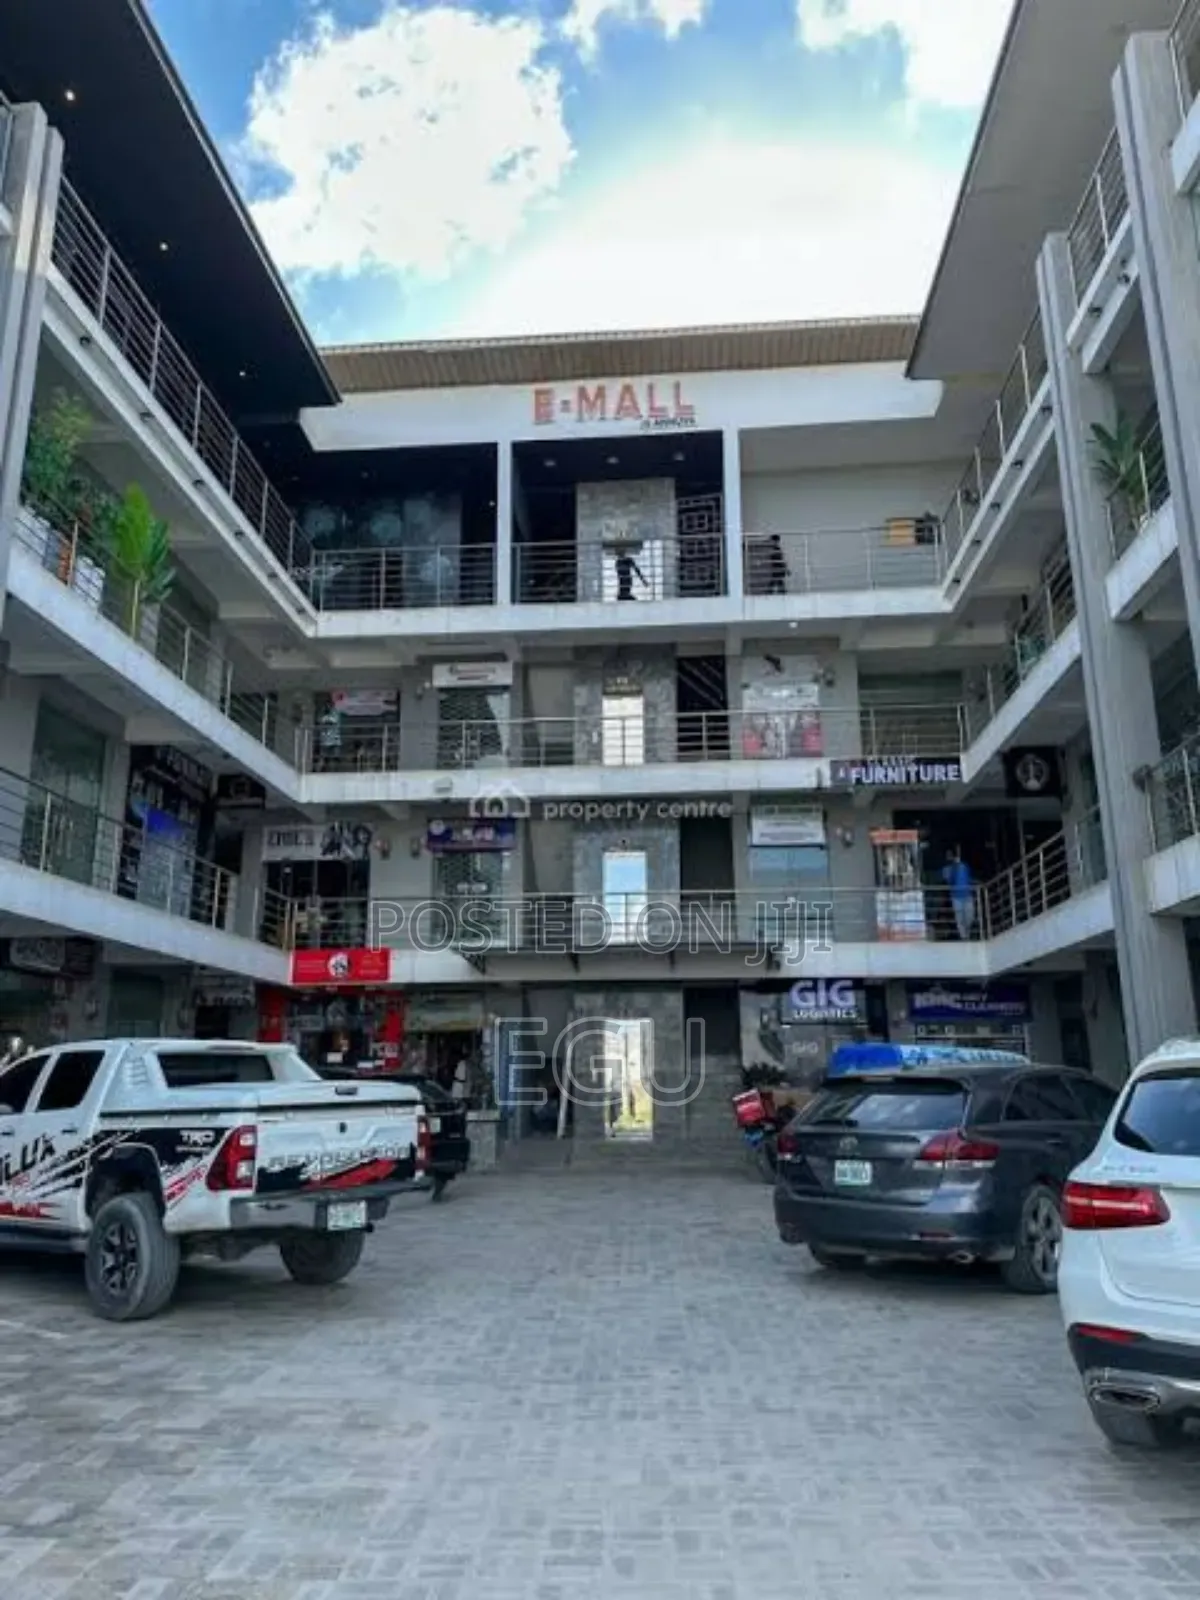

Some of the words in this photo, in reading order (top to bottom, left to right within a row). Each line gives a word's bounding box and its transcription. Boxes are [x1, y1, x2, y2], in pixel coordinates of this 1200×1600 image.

[533, 380, 696, 424] E-MALL
[851, 764, 961, 784] FURNITURE
[789, 979, 856, 1007] GIG
[180, 1129, 216, 1145] TRD
